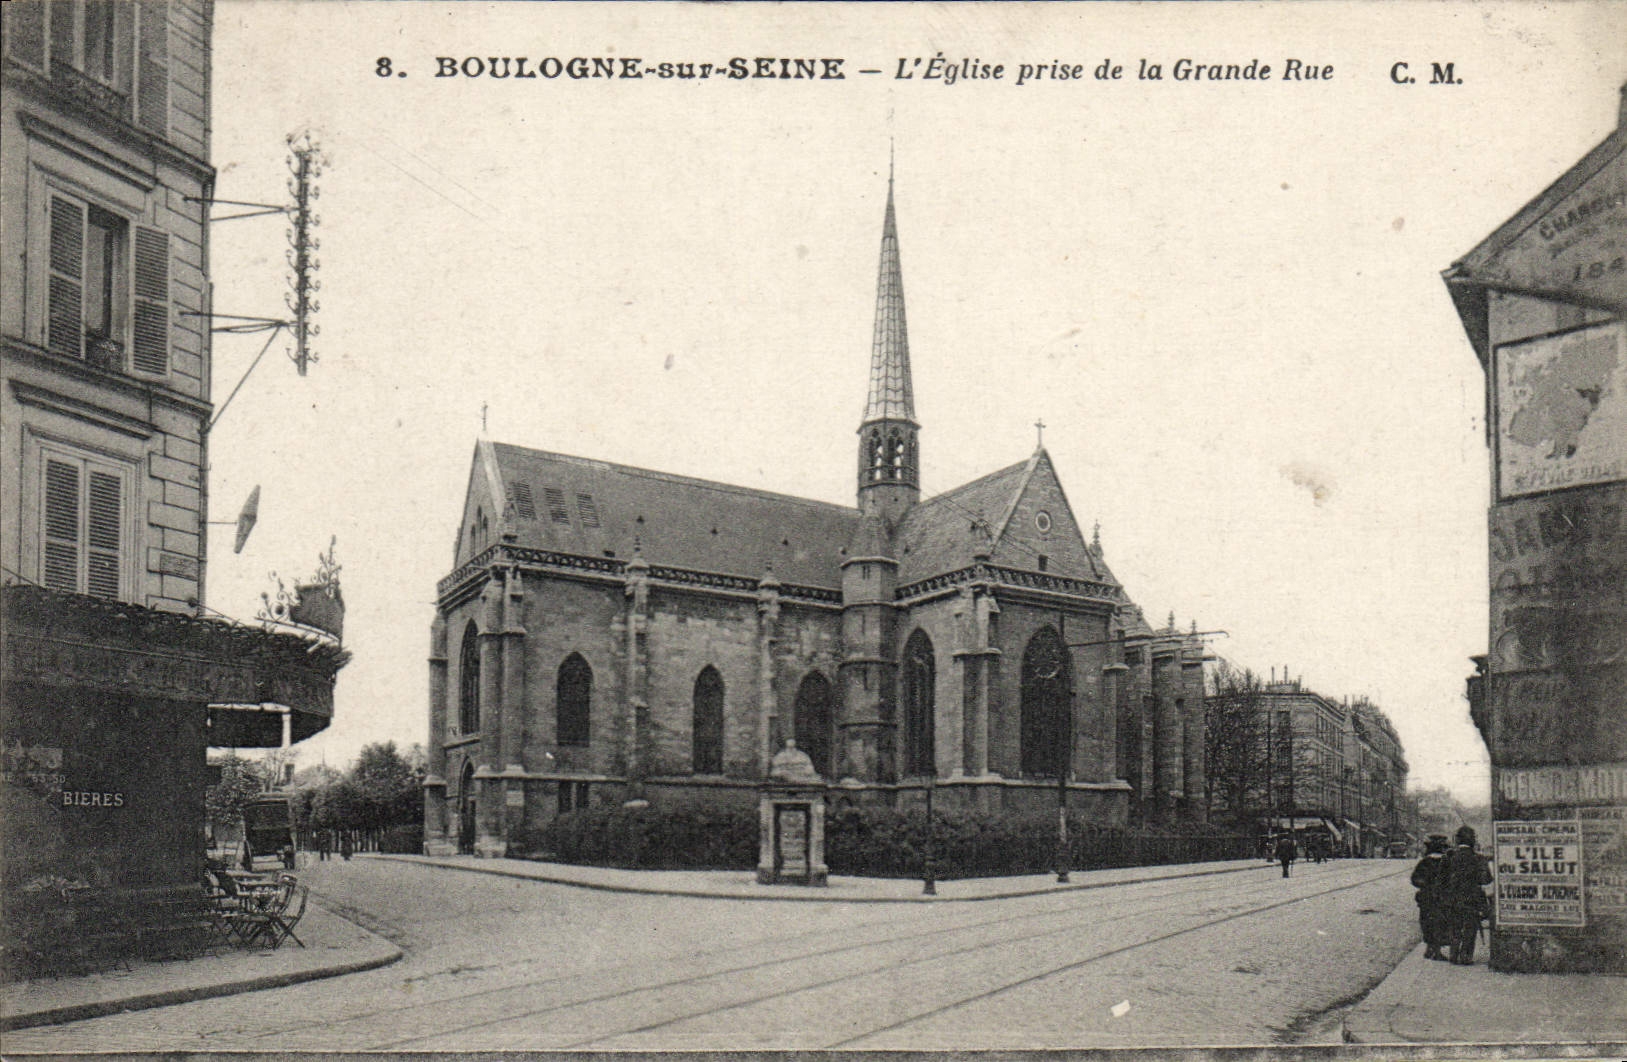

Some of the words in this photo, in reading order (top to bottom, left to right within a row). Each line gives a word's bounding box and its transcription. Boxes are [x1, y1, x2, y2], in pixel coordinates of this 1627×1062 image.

[63, 791, 124, 807] BIERES
[1515, 846, 1565, 860] L'ILE
[1519, 861, 1577, 875] SALUT
